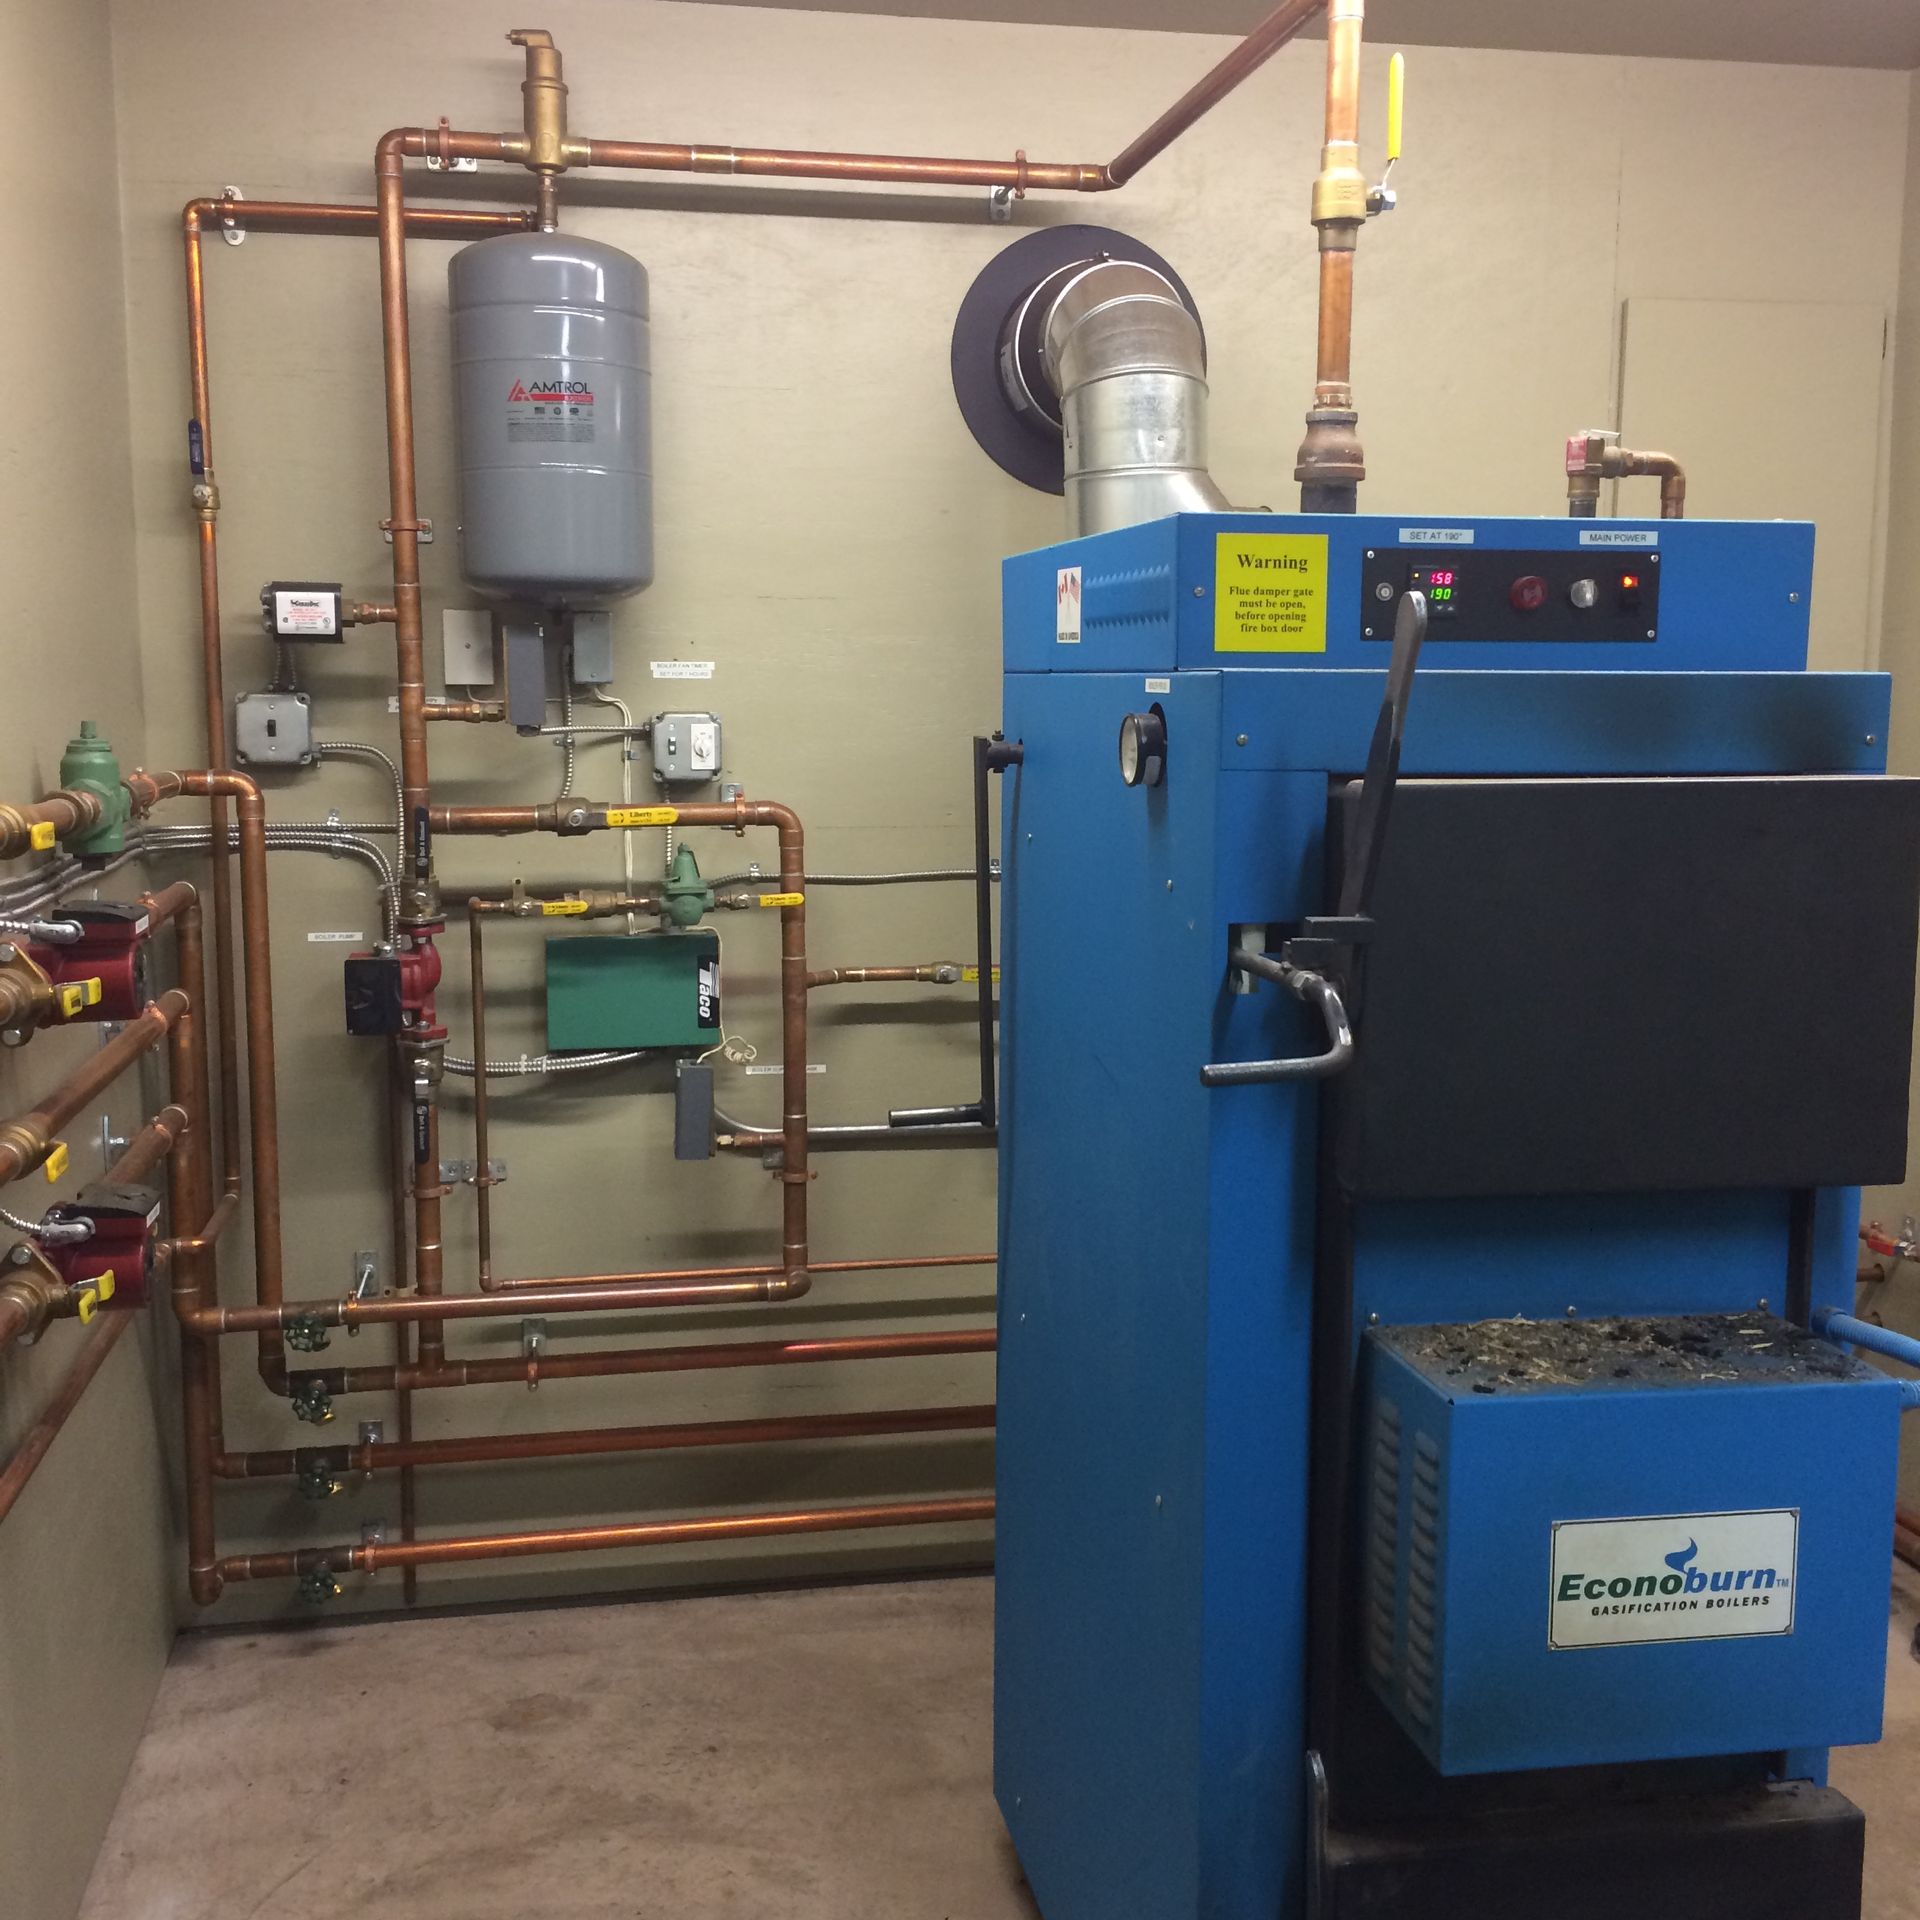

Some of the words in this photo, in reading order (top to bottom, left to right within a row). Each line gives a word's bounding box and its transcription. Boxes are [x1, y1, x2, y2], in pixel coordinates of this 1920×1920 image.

[529, 381, 592, 394] AMTROL
[1409, 531, 1428, 540] SET
[1430, 531, 1443, 540] AT
[1589, 533, 1612, 542] MAIN
[1614, 534, 1648, 542] POWER
[1237, 553, 1309, 574] Warning
[1430, 572, 1453, 585] 158
[1229, 586, 1251, 596] Flue
[1253, 586, 1291, 598] damper
[1293, 588, 1315, 598] gate
[1430, 587, 1452, 600] 190
[1239, 600, 1264, 609] must
[1265, 599, 1278, 609] be
[1279, 602, 1307, 611] open,
[1234, 611, 1266, 621] before
[1268, 612, 1307, 623] opening
[1240, 623, 1259, 633] fire
[1260, 623, 1279, 633] box
[1281, 624, 1304, 633] door
[699, 961, 720, 1019] Taco
[1557, 1566, 1777, 1602] Econoburn
[1591, 1600, 1699, 1617] GASIFICATION
[1705, 1595, 1771, 1610] BOILERS
